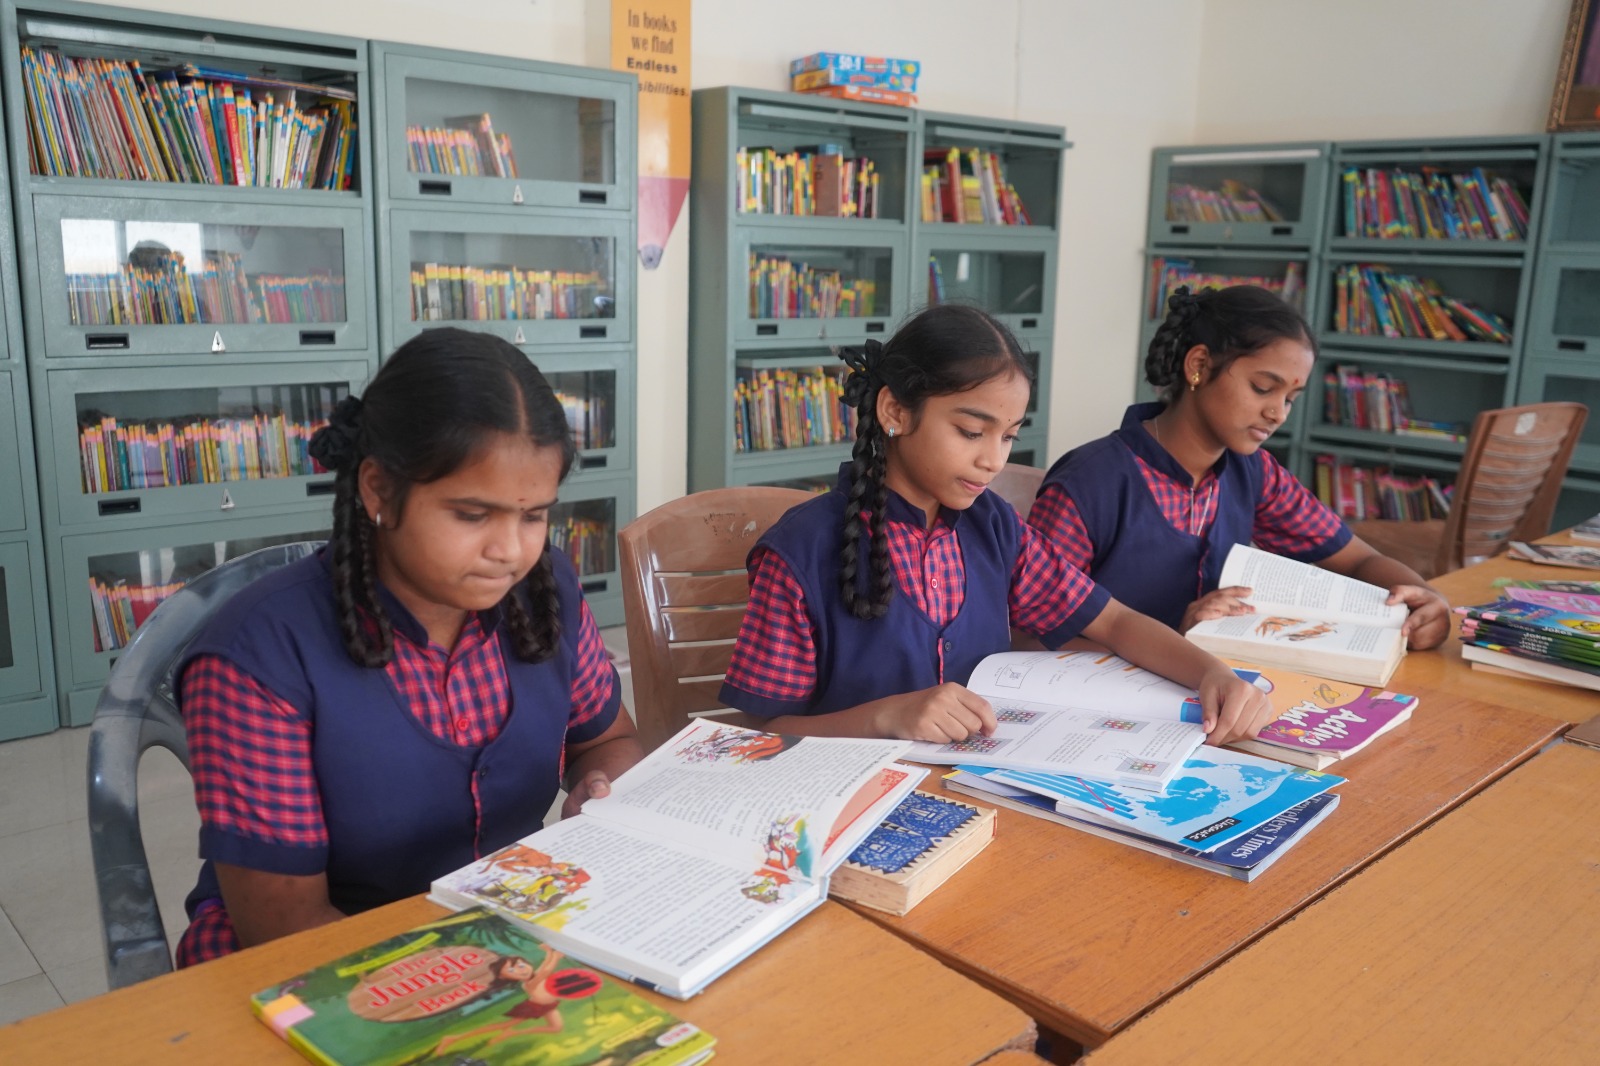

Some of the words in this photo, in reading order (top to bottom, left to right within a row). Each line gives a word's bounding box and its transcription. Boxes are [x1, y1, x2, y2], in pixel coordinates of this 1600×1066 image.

[628, 9, 640, 28] In
[643, 12, 677, 33] books
[631, 36, 649, 51] we
[651, 35, 674, 54] find
[627, 57, 677, 74] Endless
[638, 81, 689, 97] sibilities.
[1523, 633, 1553, 641] Jokes
[1541, 626, 1573, 636] Jokes
[1520, 645, 1548, 653] Jokes
[1298, 708, 1368, 746] Active
[1231, 833, 1278, 859] Times
[388, 955, 432, 977] The
[368, 951, 485, 1008] Jungle
[418, 979, 487, 1012] Book
